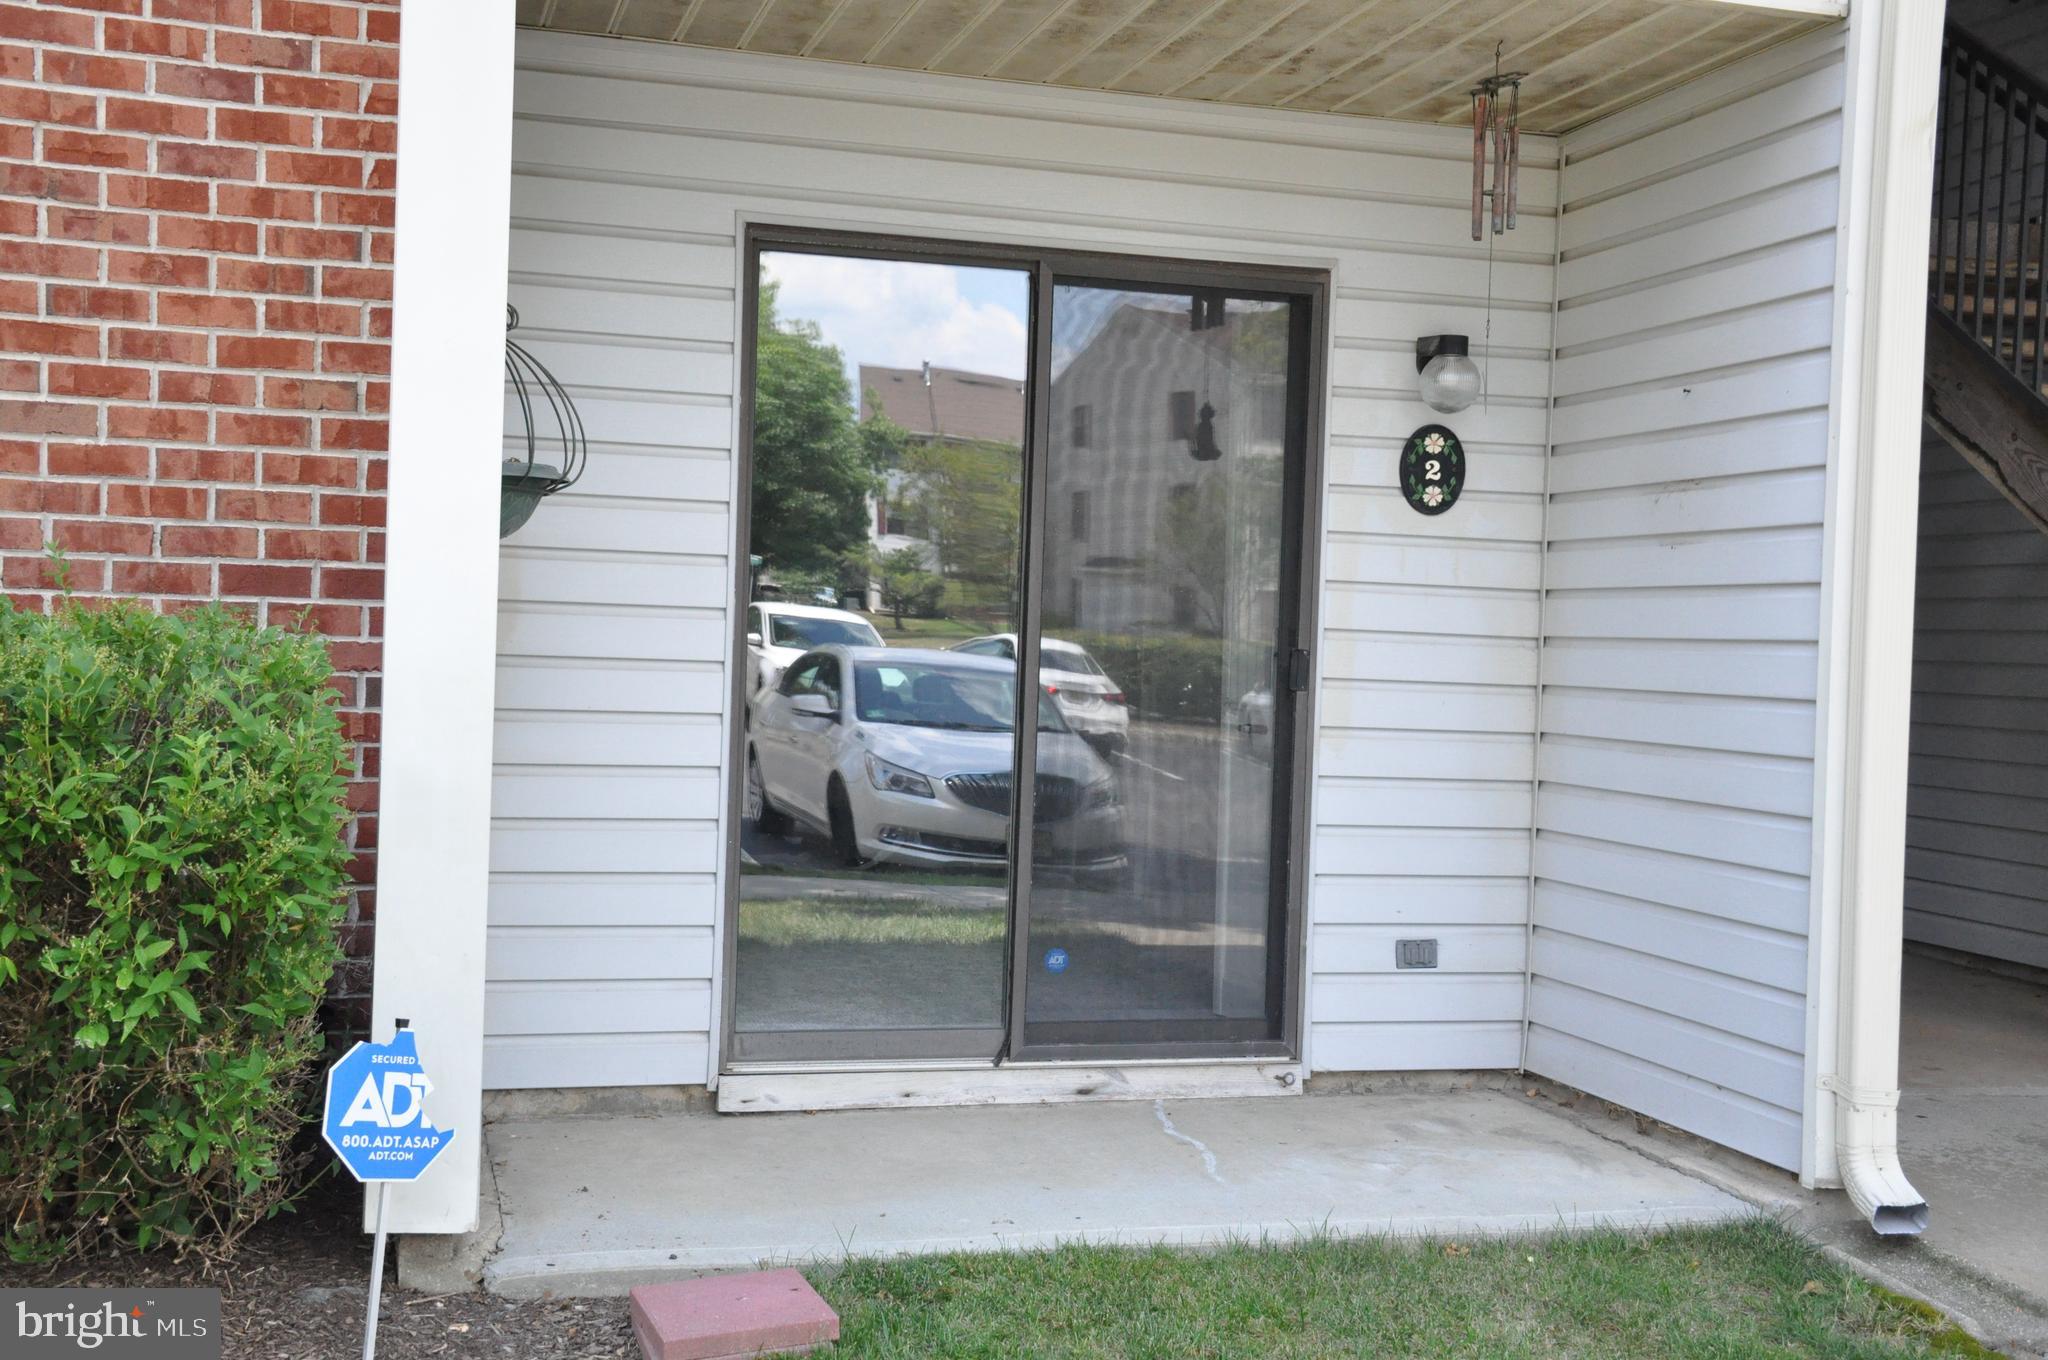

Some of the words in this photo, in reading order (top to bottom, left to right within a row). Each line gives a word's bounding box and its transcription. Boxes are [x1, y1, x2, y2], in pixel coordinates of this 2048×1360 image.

[1425, 460, 1441, 480] 2
[371, 1055, 416, 1065] SECURED
[339, 1071, 434, 1129] ADT
[341, 1135, 440, 1148] 800.ADT.ASAP
[368, 1151, 413, 1161] ADT.COM
